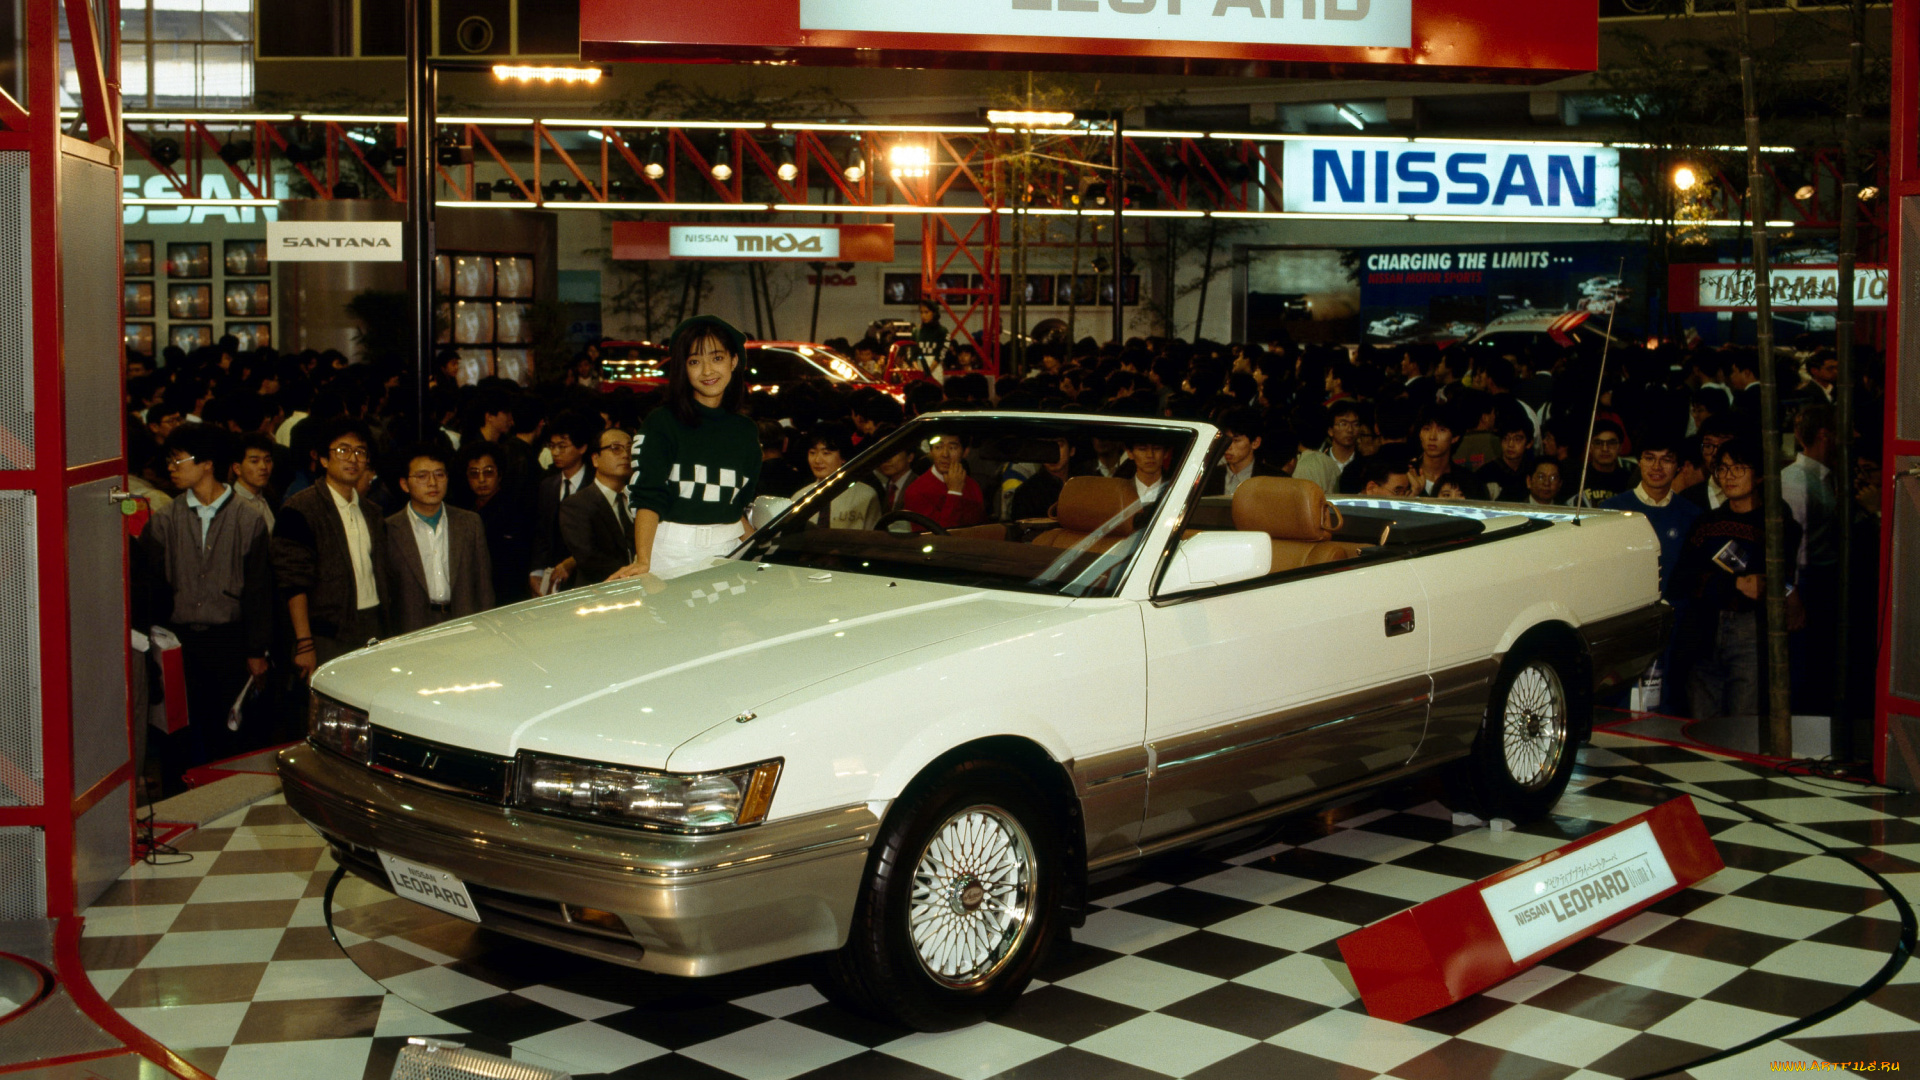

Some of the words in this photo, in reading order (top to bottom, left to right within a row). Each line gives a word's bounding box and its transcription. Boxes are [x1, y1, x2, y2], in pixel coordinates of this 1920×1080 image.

[1313, 149, 1596, 207] NISSAN
[283, 237, 391, 248] SANTANA
[685, 234, 729, 243] NISSAN
[1367, 253, 1451, 270] CHARGING
[1458, 253, 1487, 269] THE
[1368, 273, 1403, 284] NISSAN
[1405, 272, 1442, 284] MOTOR
[1443, 271, 1482, 283] SPORTS
[408, 867, 437, 882] NISSAN
[391, 870, 468, 908] LEOPARD
[1515, 902, 1550, 926] NISSAN
[1549, 869, 1630, 923] LEOPARD
